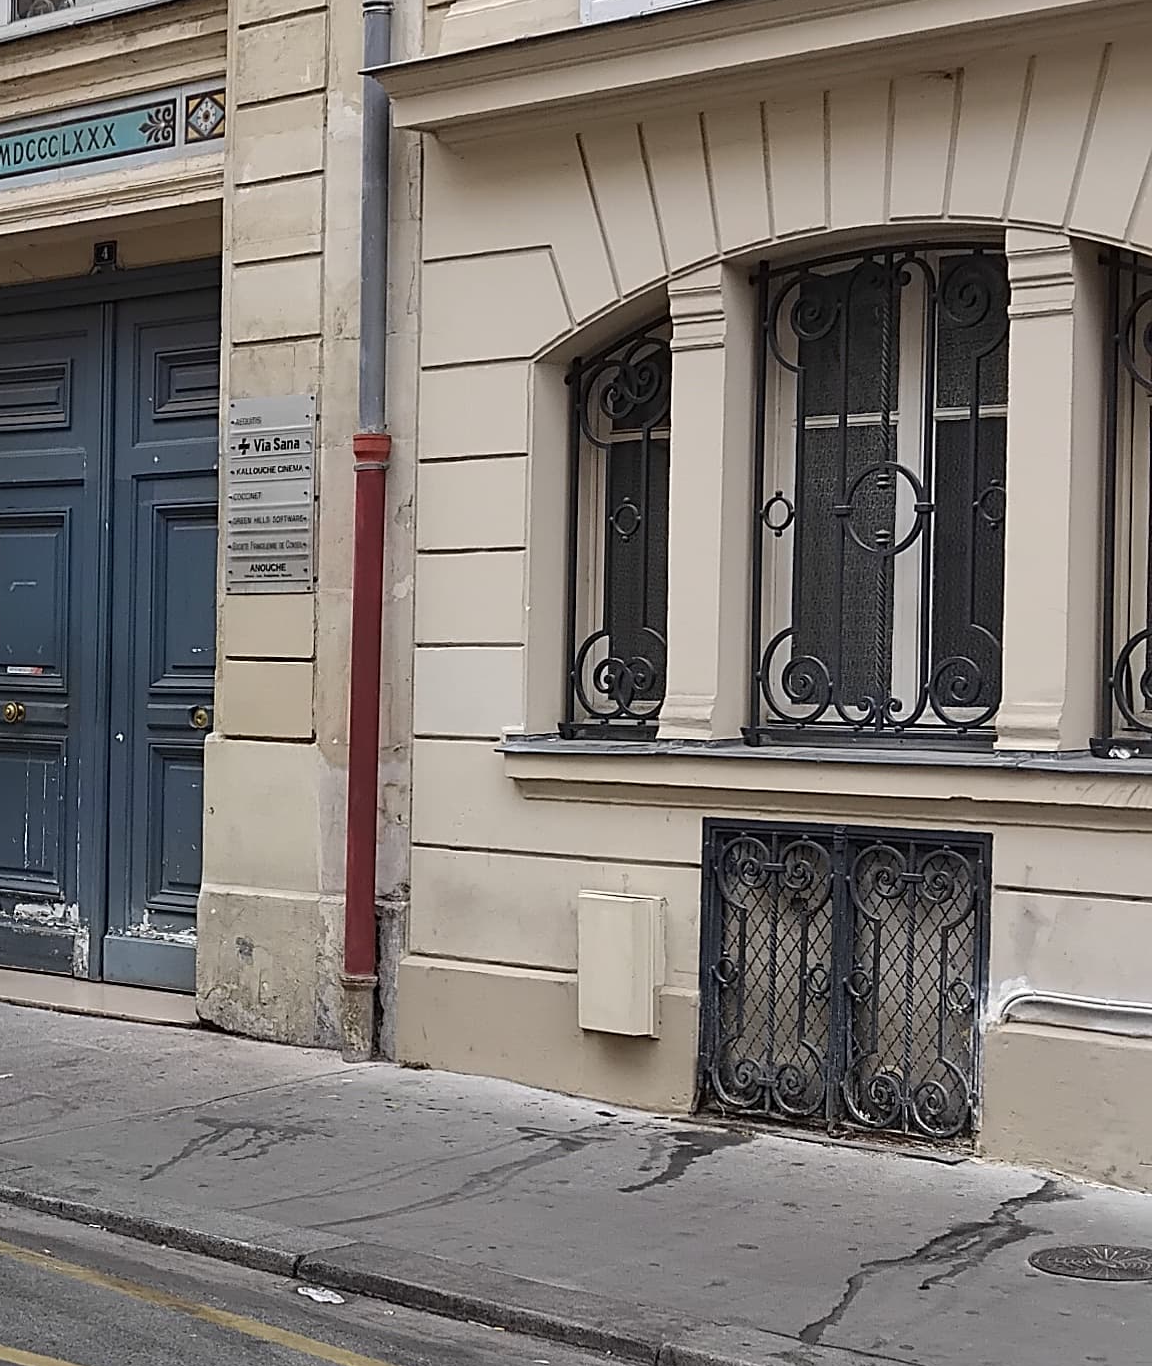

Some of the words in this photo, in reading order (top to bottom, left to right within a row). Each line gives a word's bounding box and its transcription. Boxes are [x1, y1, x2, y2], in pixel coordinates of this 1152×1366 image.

[254, 438, 271, 453] Via
[273, 437, 300, 451] Sana
[277, 464, 304, 473] CINEMA
[249, 563, 287, 573] ANOUCHE
